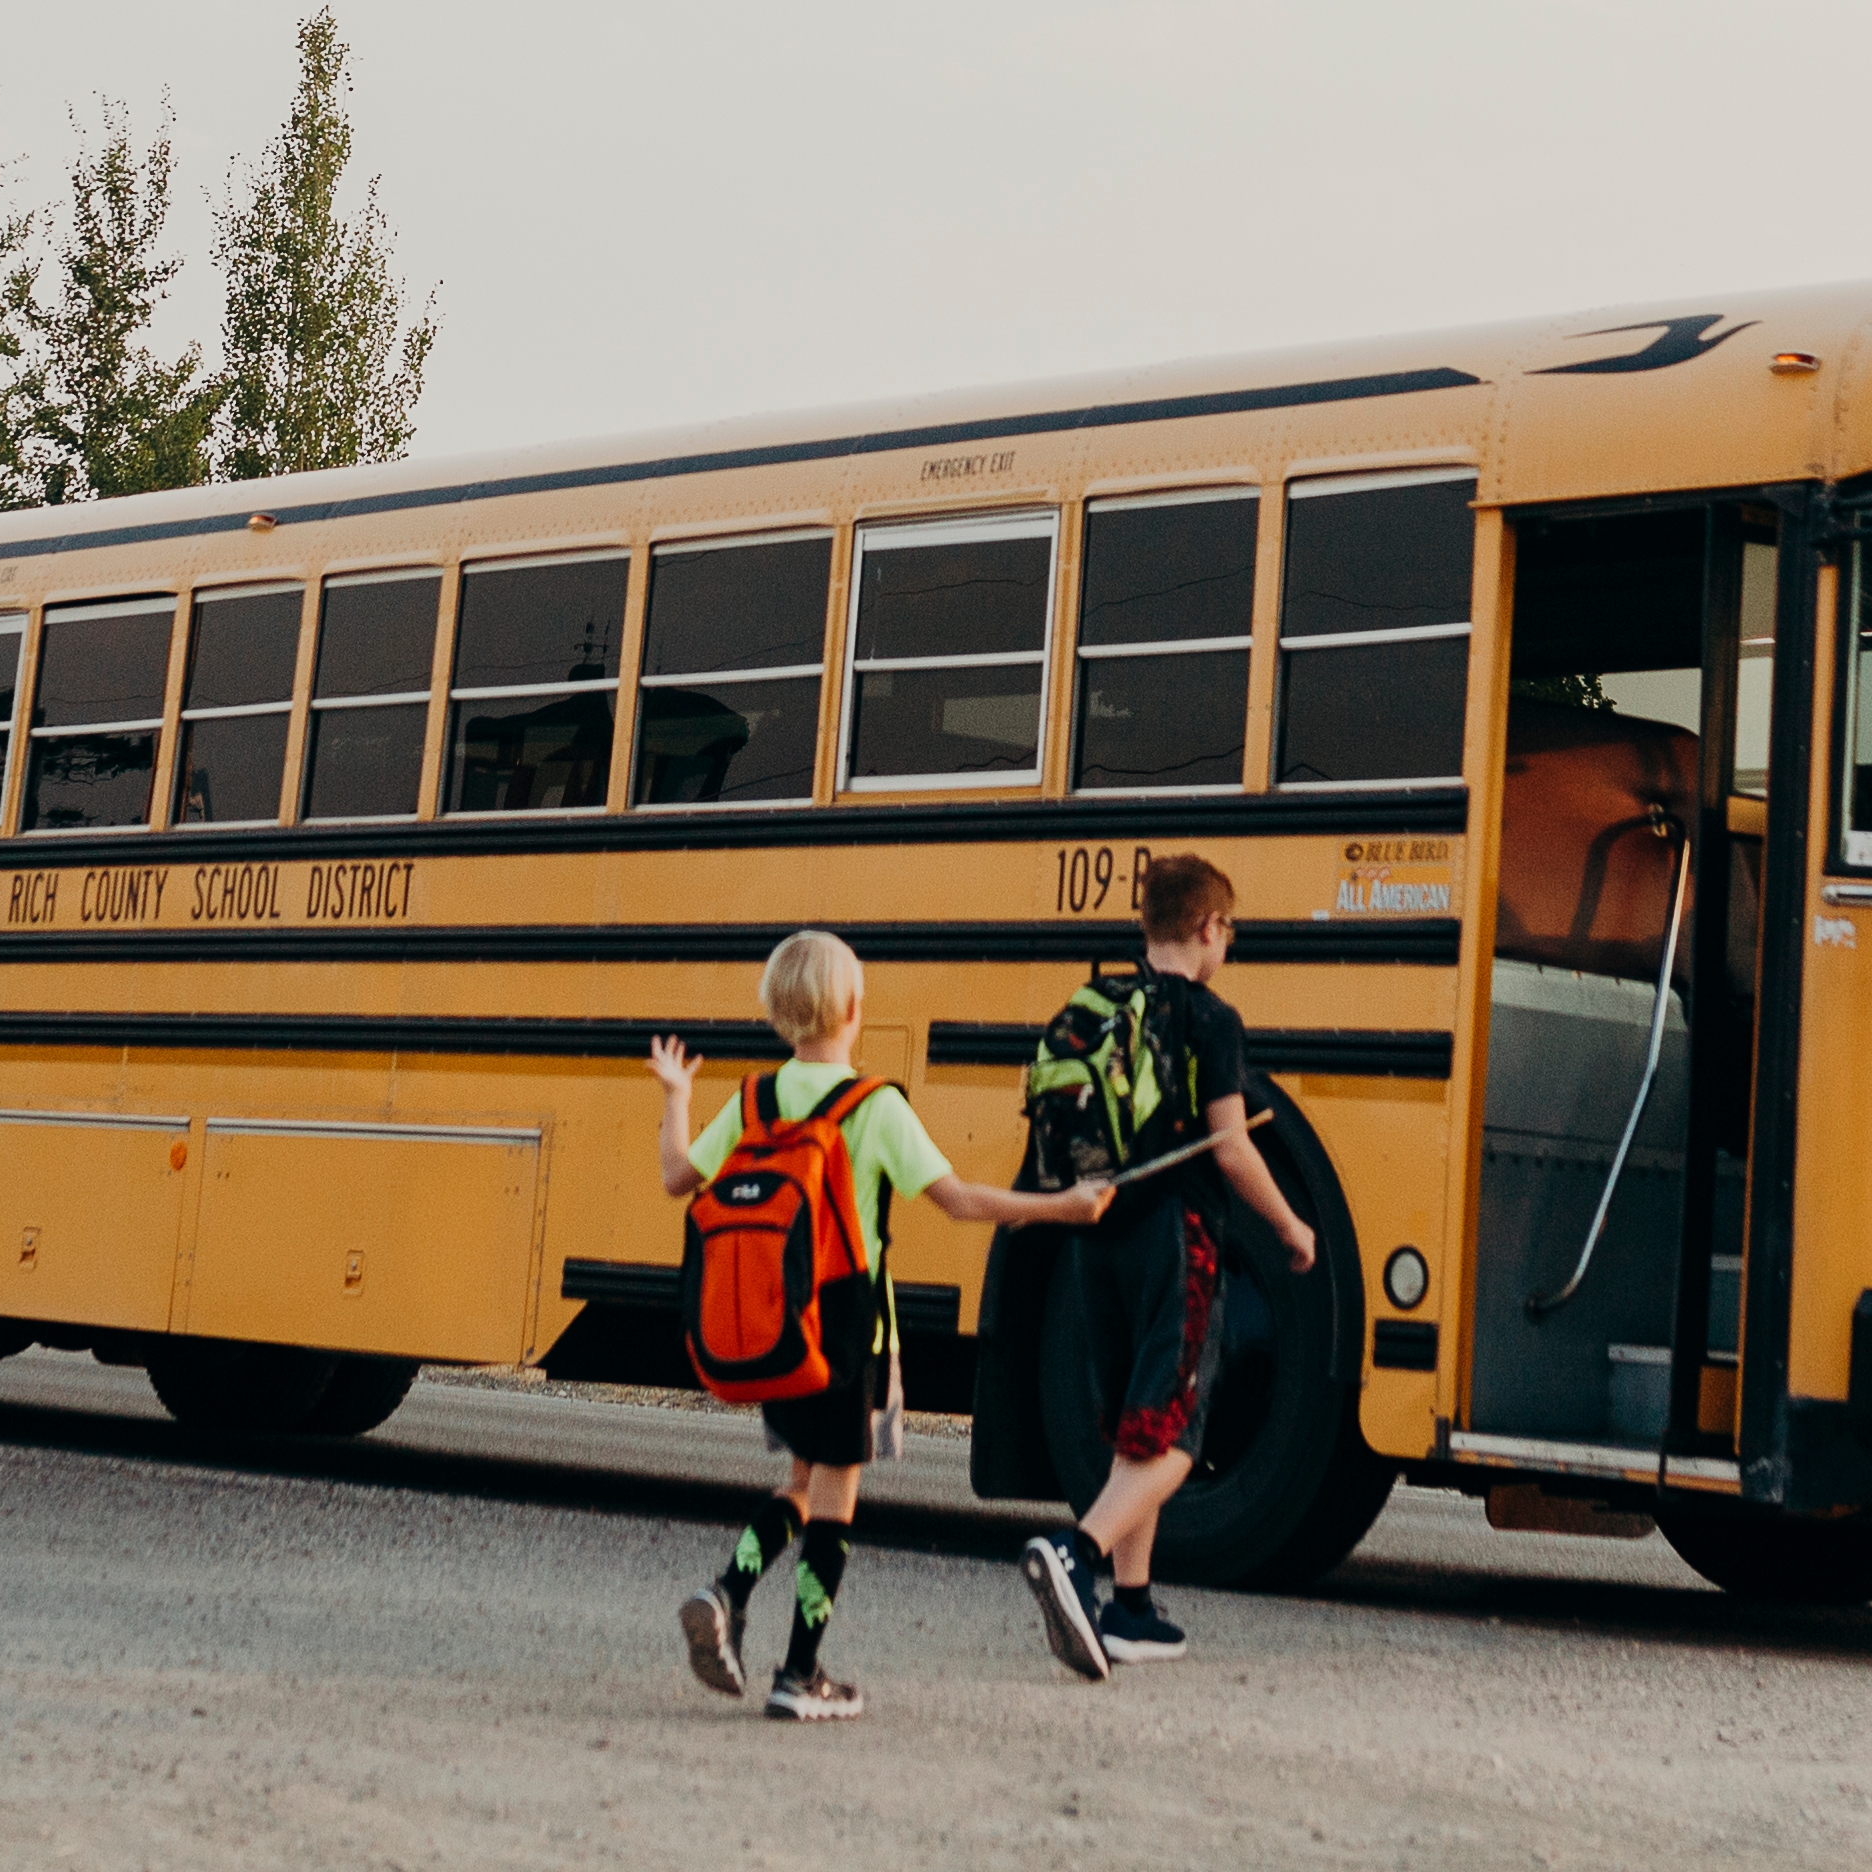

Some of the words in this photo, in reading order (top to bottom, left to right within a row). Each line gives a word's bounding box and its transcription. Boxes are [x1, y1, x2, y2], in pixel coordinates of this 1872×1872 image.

[8, 871, 60, 924] RICH
[80, 868, 169, 923] COUNTY
[191, 862, 281, 921] SCHOOL
[306, 862, 416, 920] DISTRICT
[1336, 879, 1367, 912] ALL
[1368, 879, 1451, 912] AMERICAN
